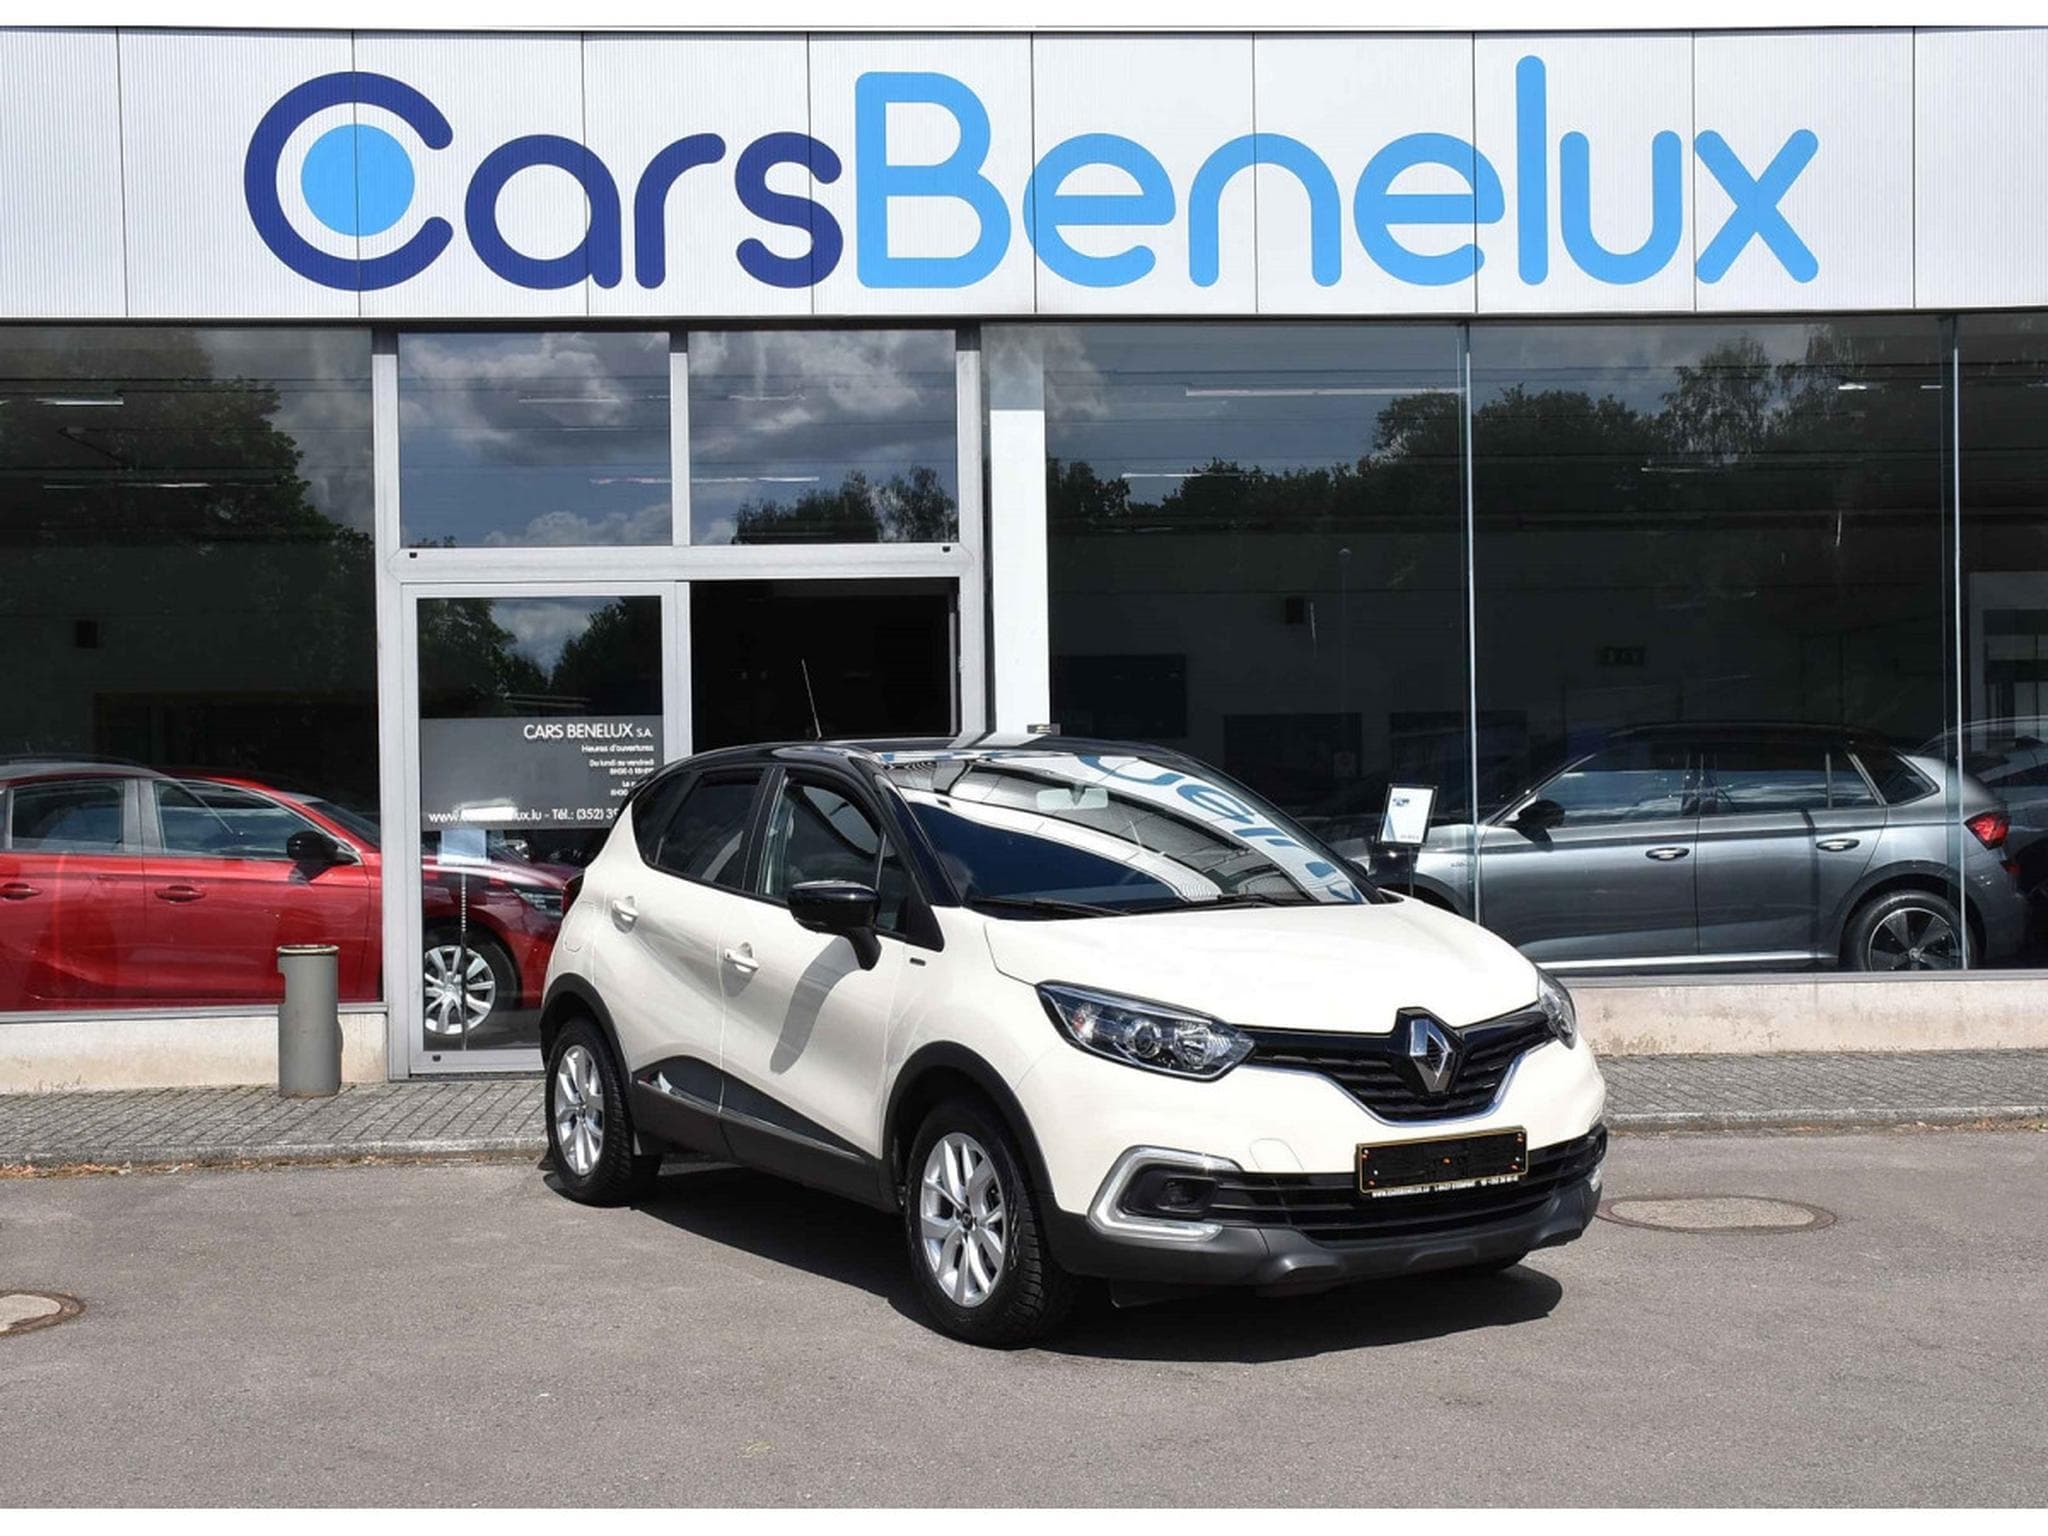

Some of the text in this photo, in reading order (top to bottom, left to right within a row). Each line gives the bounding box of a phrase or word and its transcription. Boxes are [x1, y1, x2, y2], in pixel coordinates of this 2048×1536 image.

[244, 55, 1819, 292] CarsBenelux
[523, 723, 564, 740] CARS
[566, 723, 634, 739] BENELUX
[581, 745, 609, 753] Heures
[576, 807, 605, 822] (352)
